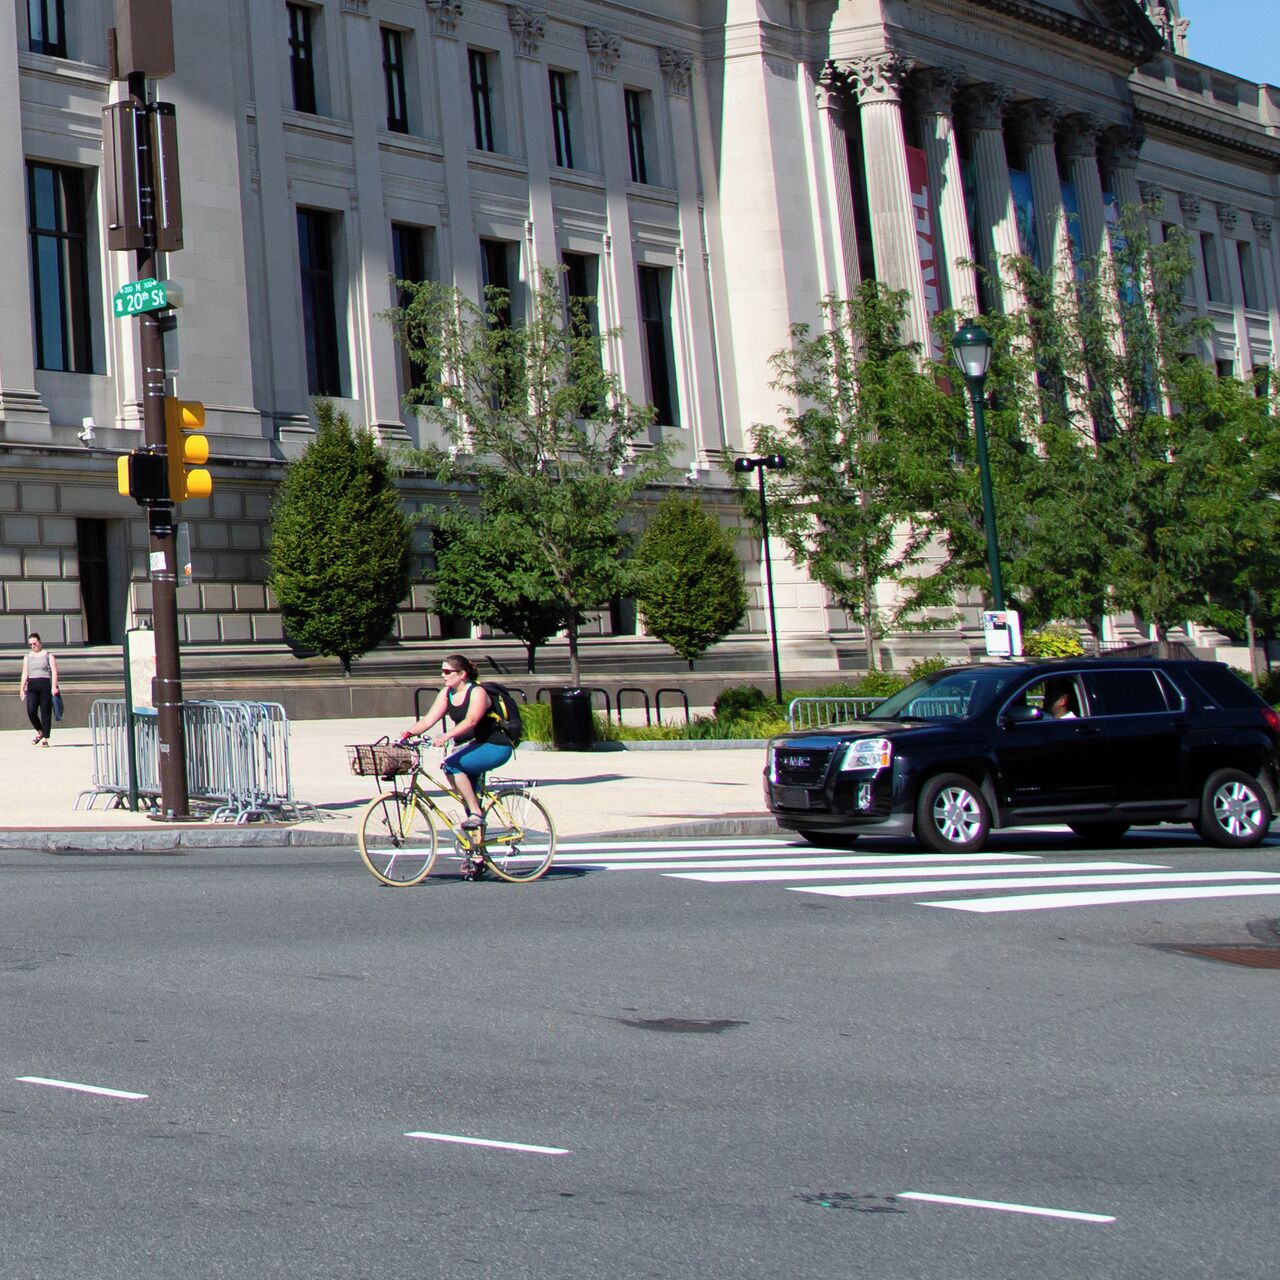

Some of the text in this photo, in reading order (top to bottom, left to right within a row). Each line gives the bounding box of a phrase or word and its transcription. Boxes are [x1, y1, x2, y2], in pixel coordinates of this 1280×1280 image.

[135, 283, 140, 292] N
[126, 289, 165, 312] 20th St
